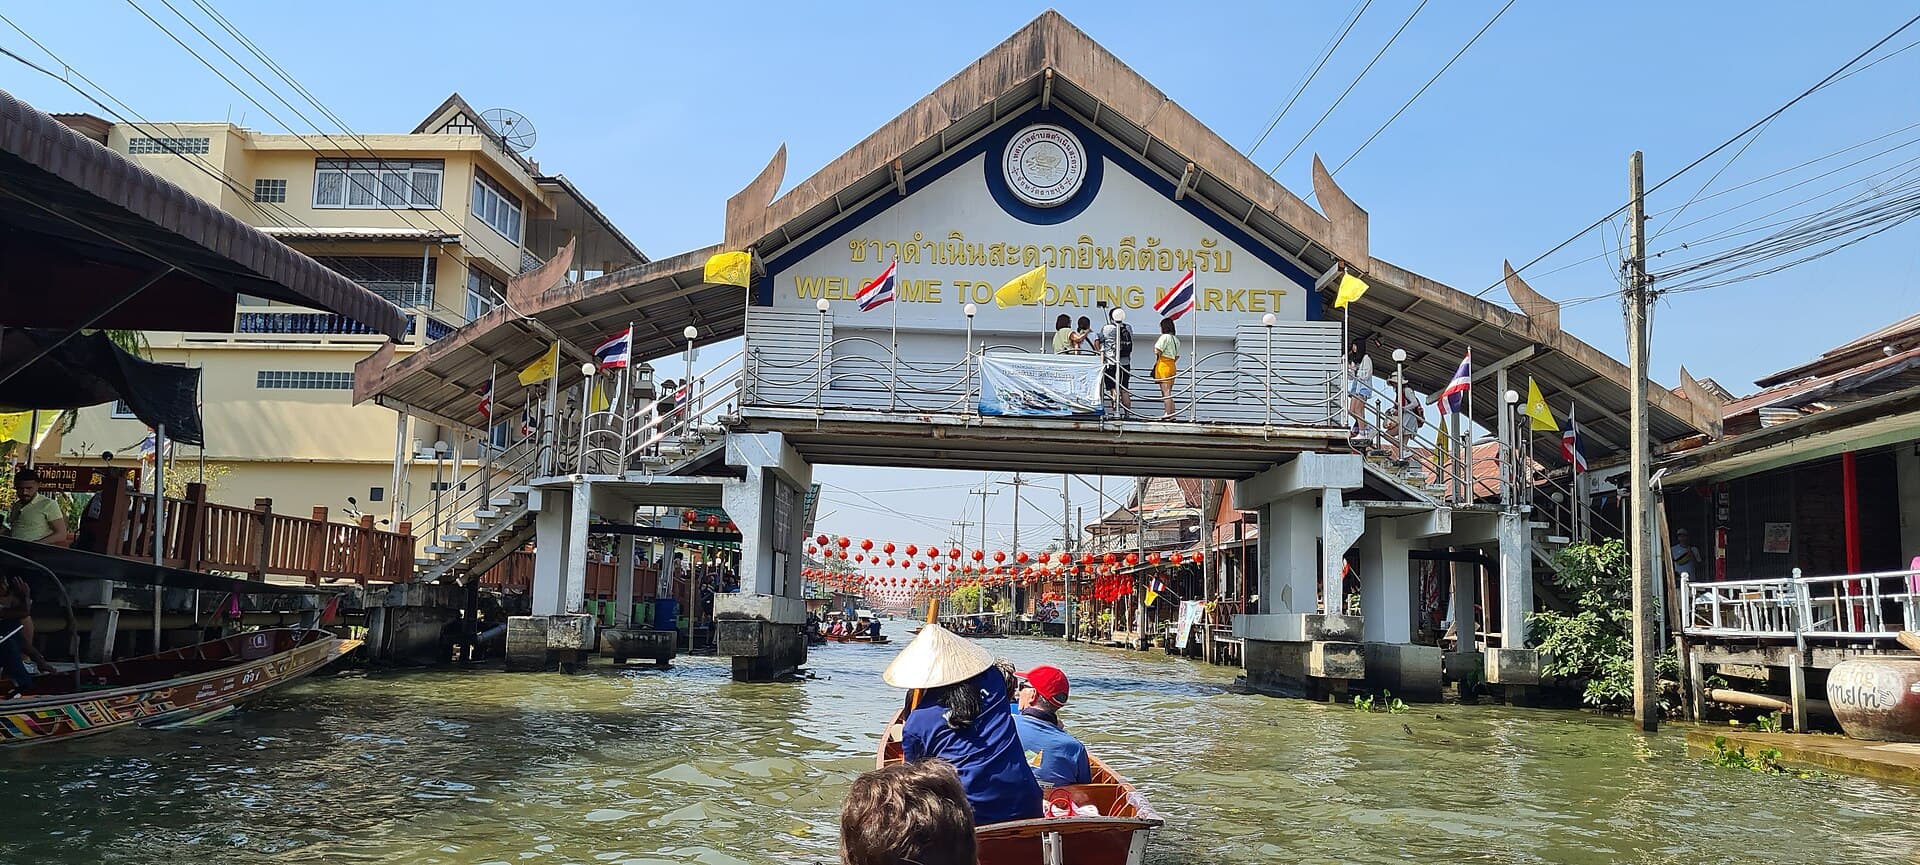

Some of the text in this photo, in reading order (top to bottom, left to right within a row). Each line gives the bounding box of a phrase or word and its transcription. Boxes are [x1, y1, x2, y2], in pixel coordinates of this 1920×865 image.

[848, 230, 1232, 273] ชาวดำเนินสะดวกยินดีต้อนรับ
[794, 275, 1287, 313] WELME TO OATING RKET
